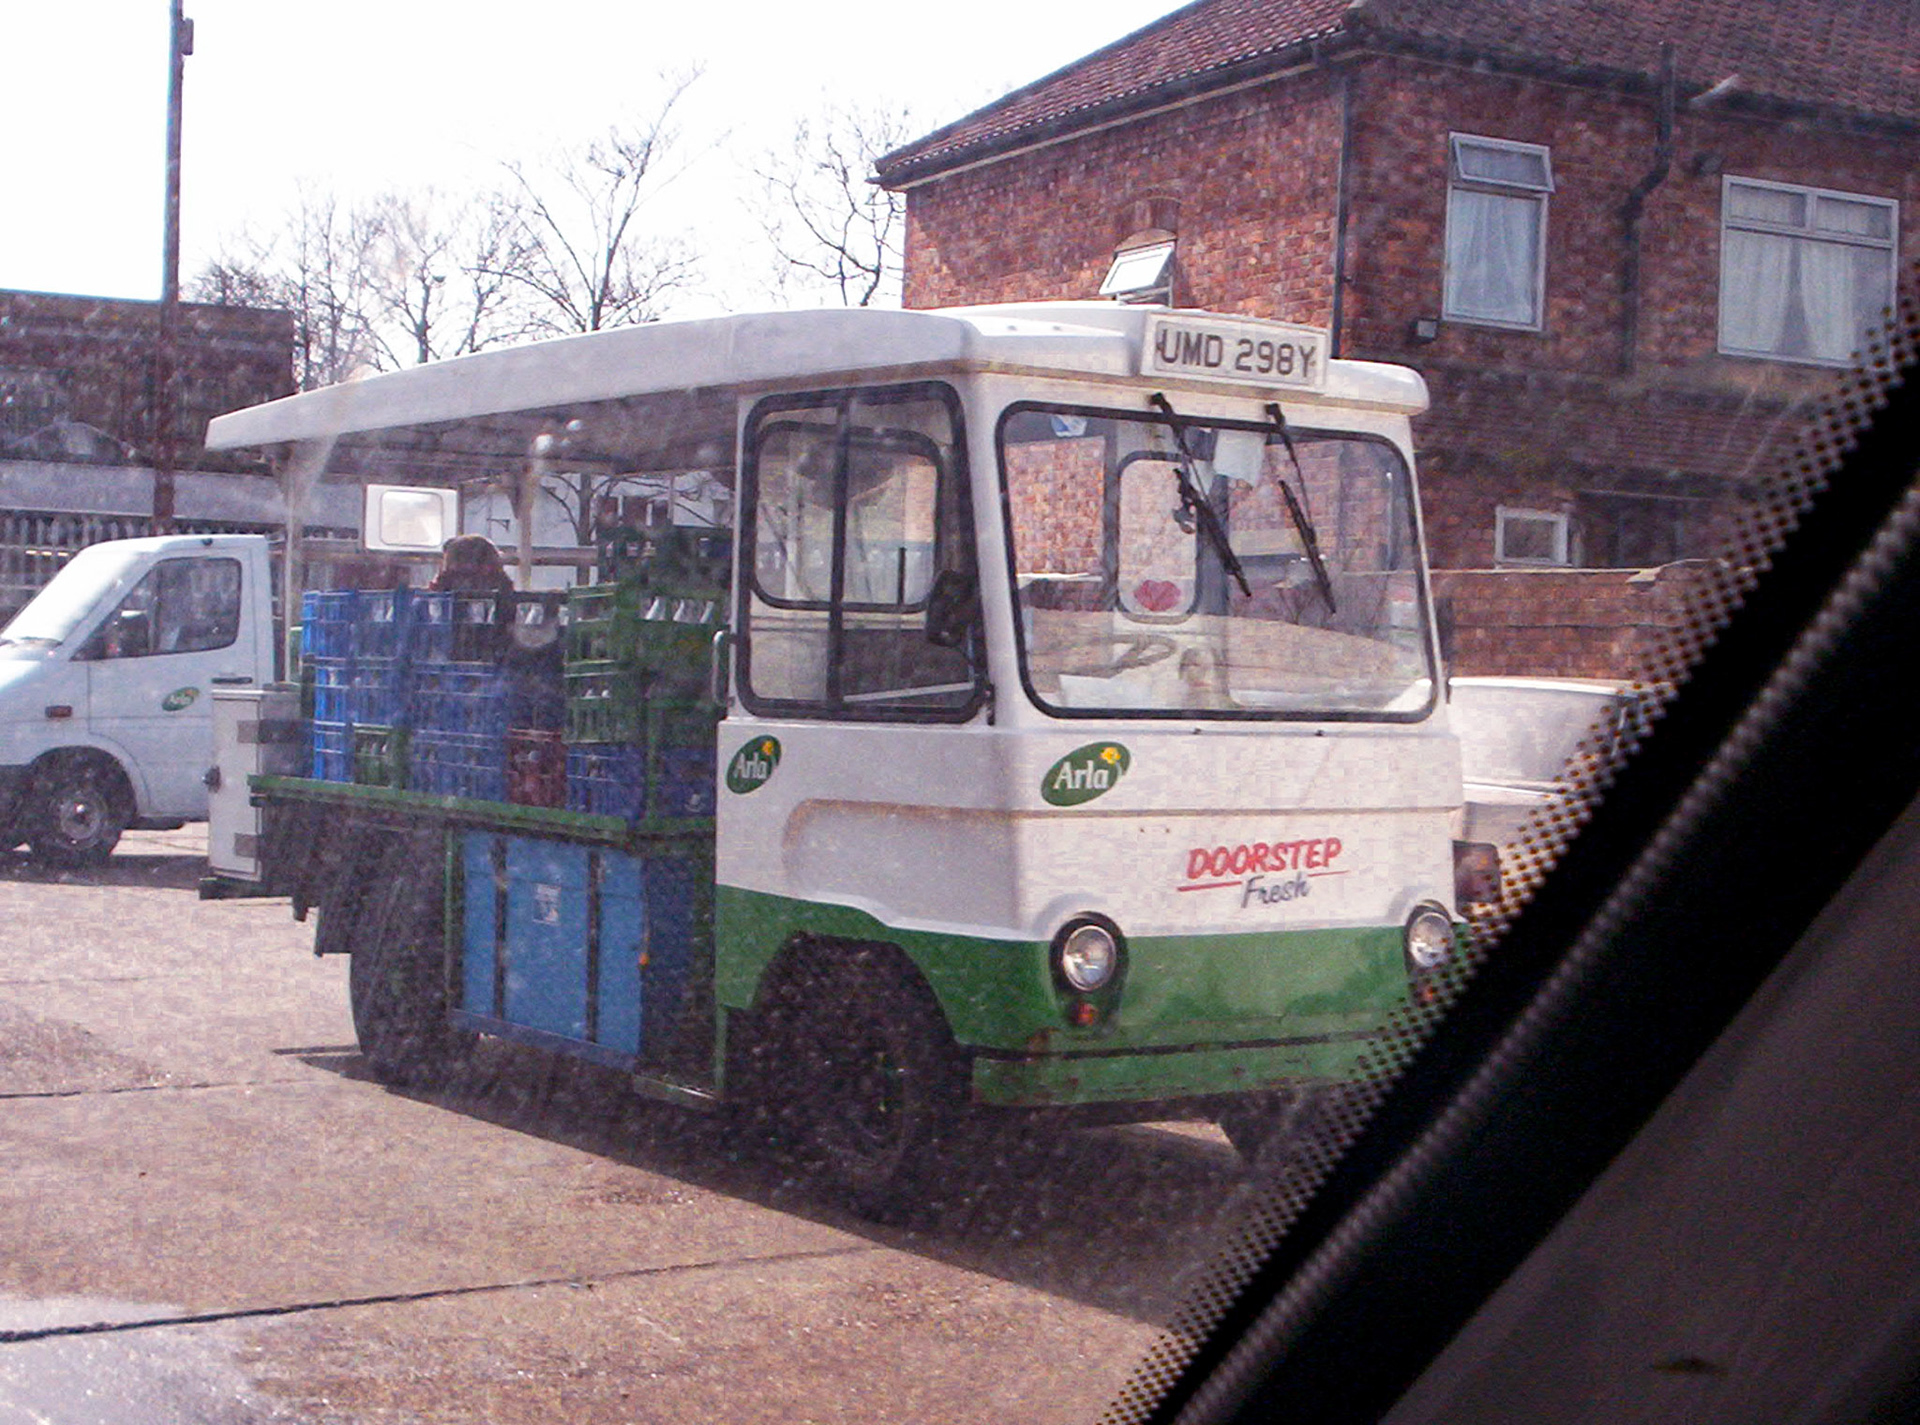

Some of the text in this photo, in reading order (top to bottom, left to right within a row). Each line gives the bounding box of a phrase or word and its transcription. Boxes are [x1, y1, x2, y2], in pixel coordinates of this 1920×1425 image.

[1161, 328, 1316, 378] UMD 298Y
[732, 752, 768, 779] Arla
[1052, 759, 1110, 790] Arla
[1186, 837, 1342, 880] DOORSTEP
[1240, 871, 1312, 909] Fresh
